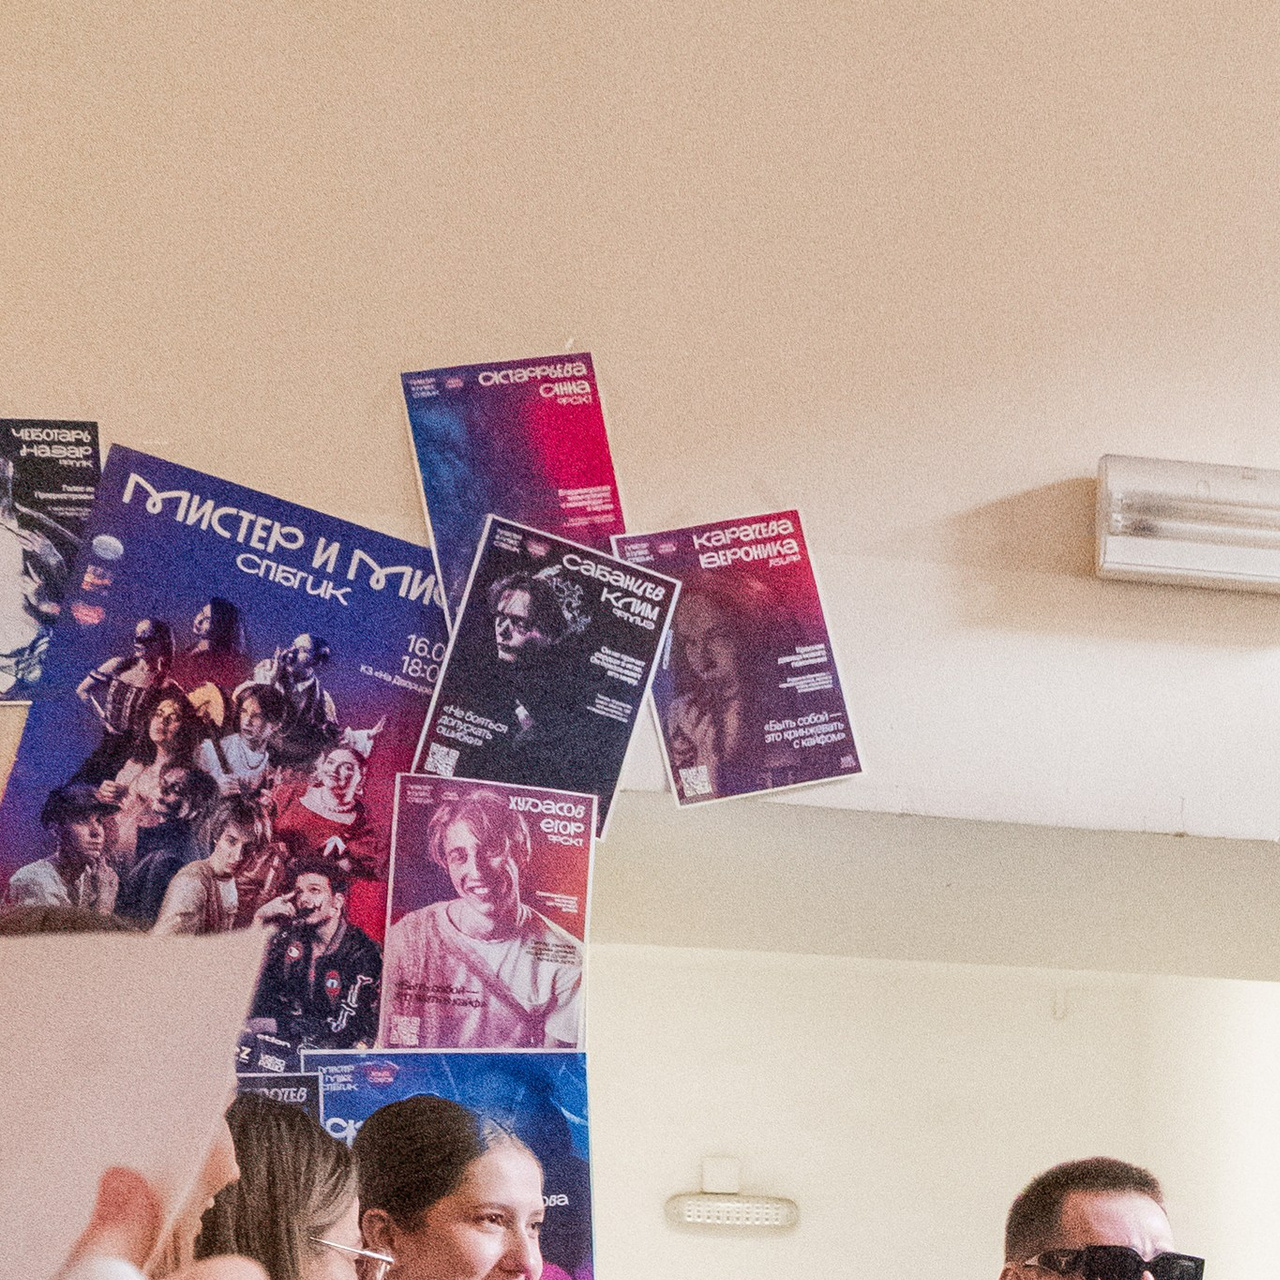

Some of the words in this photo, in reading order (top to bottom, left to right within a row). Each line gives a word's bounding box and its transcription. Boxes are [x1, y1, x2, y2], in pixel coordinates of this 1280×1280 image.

[122, 472, 304, 553] МИСТЕР
[311, 537, 341, 571] И
[601, 587, 660, 621] КЛИМ
[407, 634, 446, 662] 16.0
[401, 656, 440, 683] 18:0
